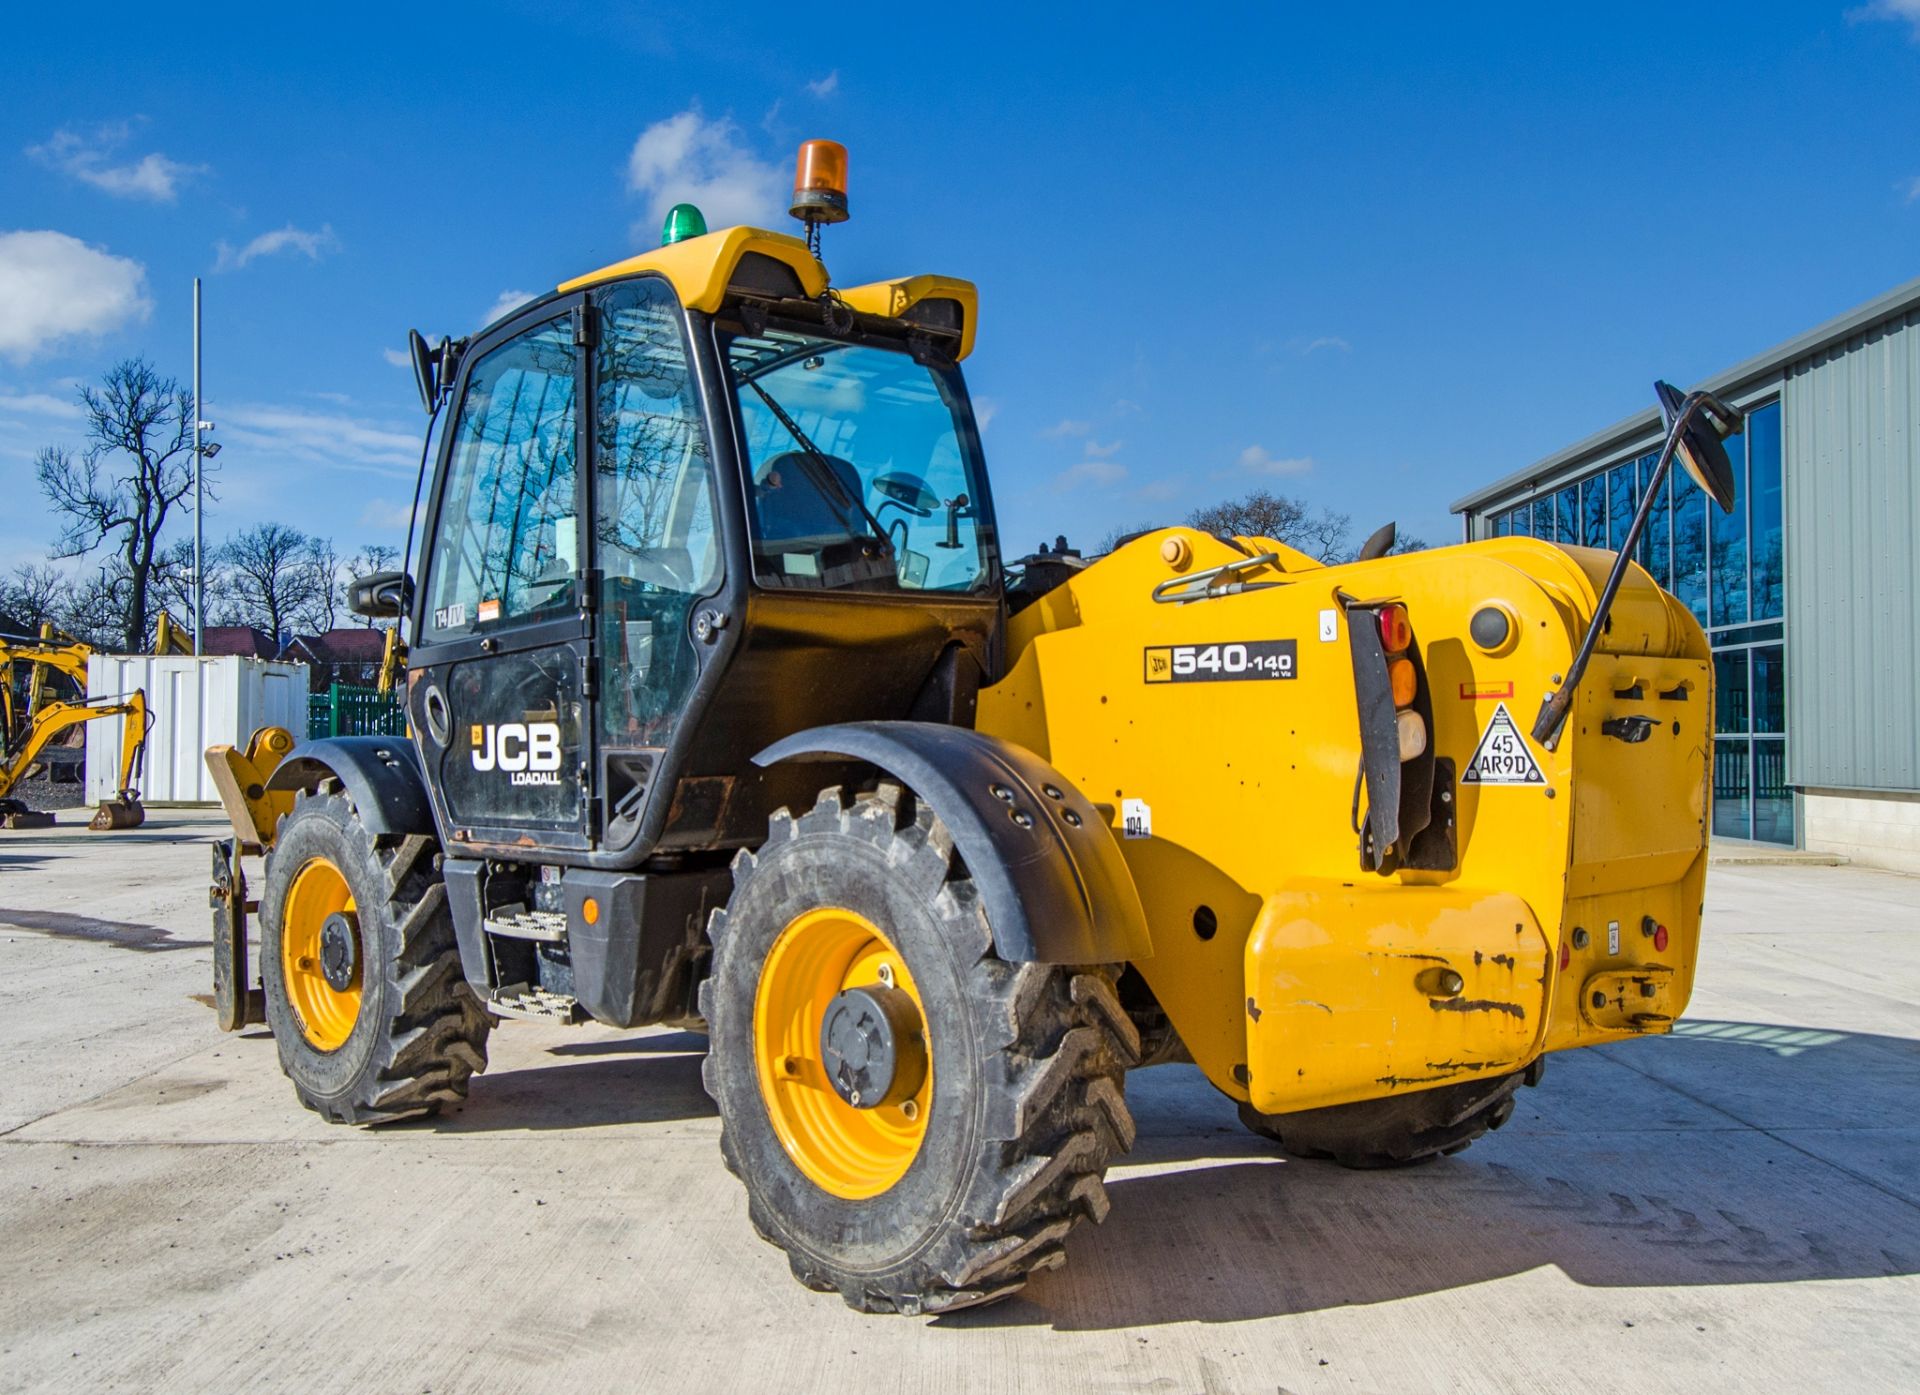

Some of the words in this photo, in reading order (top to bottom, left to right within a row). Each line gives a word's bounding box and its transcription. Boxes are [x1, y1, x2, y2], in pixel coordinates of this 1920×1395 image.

[435, 609, 448, 628] T4
[472, 723, 562, 772] JCB
[1491, 735, 1513, 754] 45
[1481, 756, 1526, 774] AR9D
[511, 772, 562, 786] LOADALL
[1126, 816, 1142, 836] 104
